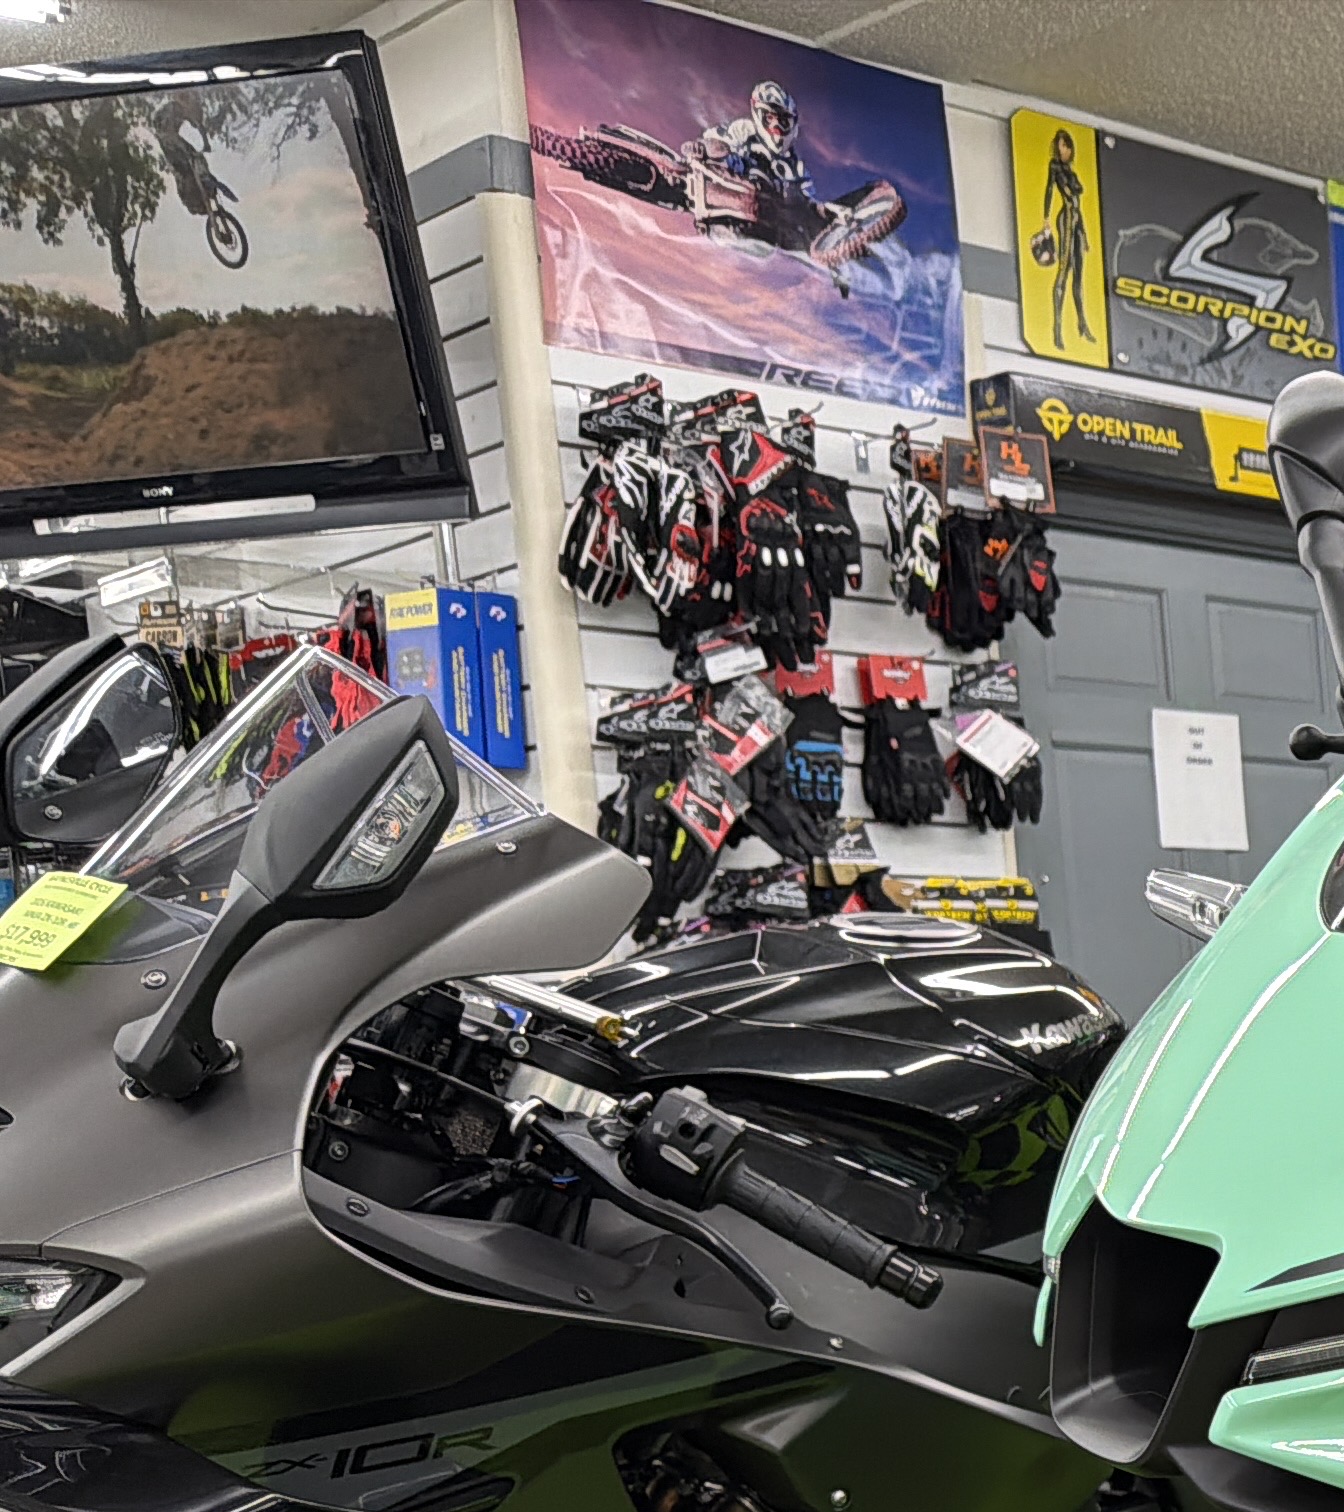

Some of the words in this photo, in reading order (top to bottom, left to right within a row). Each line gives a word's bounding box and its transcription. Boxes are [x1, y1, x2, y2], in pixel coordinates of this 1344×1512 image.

[1115, 276, 1310, 336] SCORPION
[1269, 332, 1336, 360] EXO
[1077, 412, 1131, 439] OPEN
[1132, 421, 1184, 449] TRAIL
[0, 923, 58, 949] $17,999
[242, 1427, 497, 1479] ZX-10R
